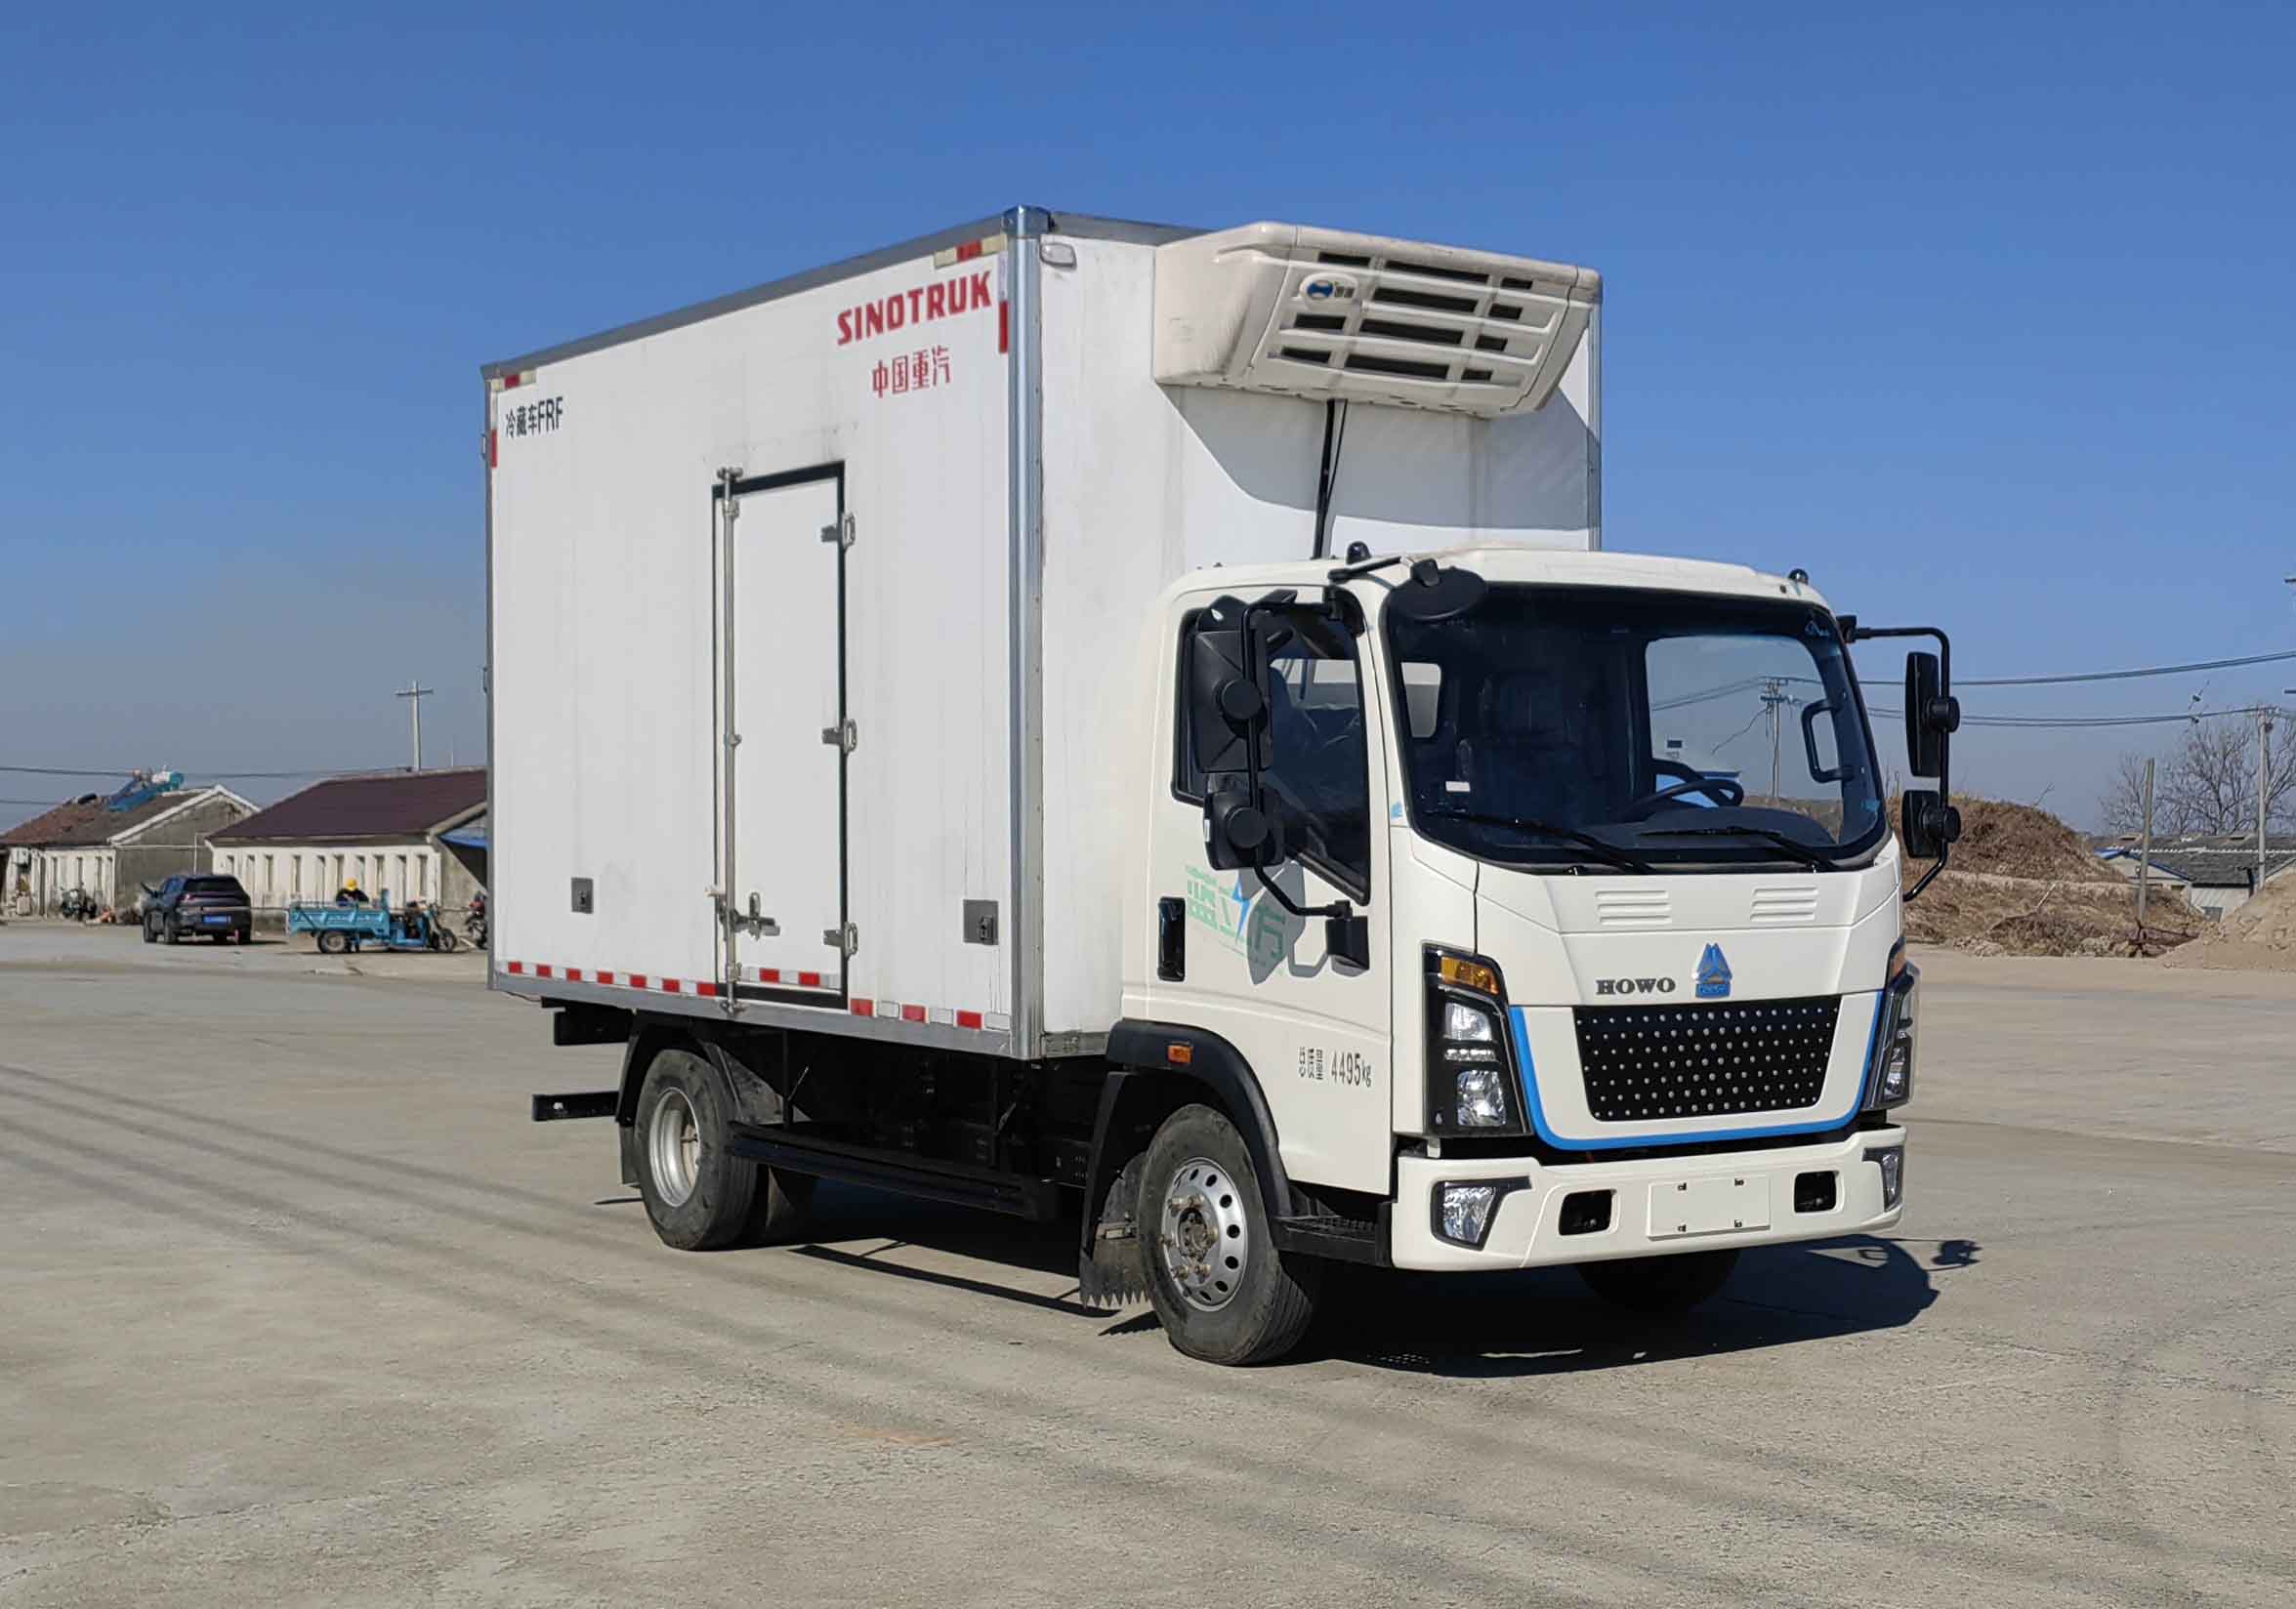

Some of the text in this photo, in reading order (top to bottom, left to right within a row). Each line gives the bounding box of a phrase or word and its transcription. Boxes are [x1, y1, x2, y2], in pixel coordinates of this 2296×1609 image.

[837, 269, 991, 346] SINOTRUK
[872, 345, 951, 399] 中国重汽
[1596, 977, 1676, 995] HOWO
